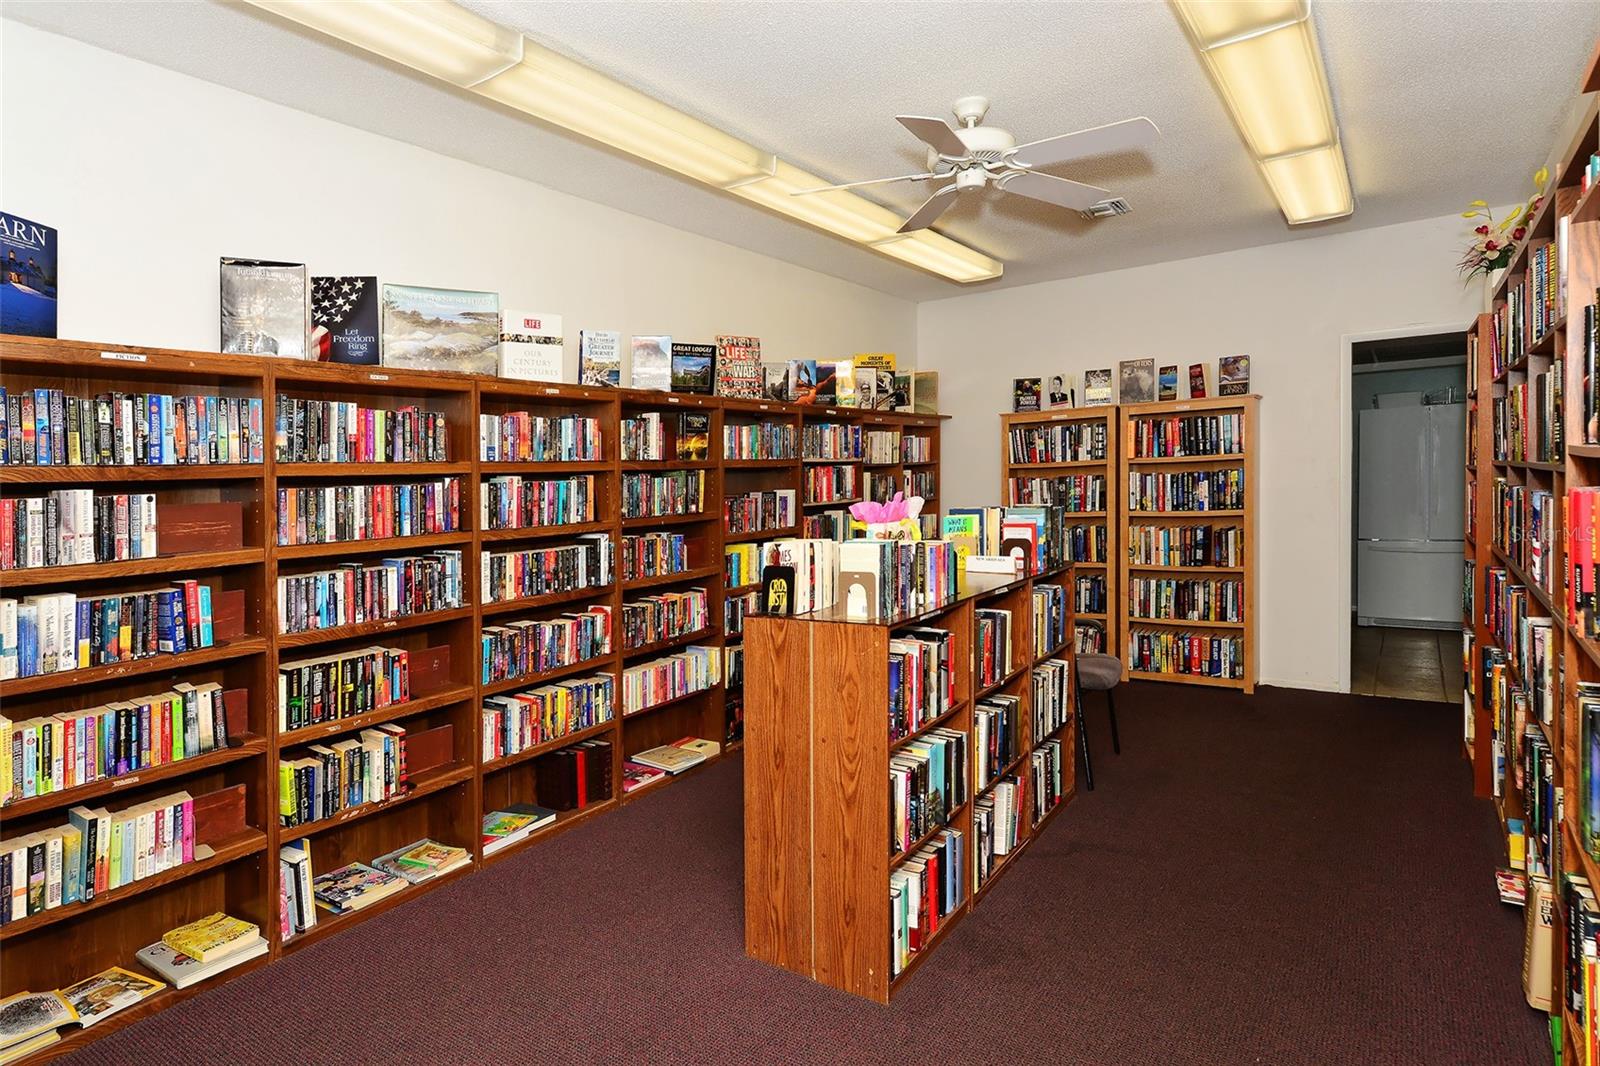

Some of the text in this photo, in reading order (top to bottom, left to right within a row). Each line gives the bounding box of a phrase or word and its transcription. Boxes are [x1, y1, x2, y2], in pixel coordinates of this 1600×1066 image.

[525, 319, 541, 329] LIFE
[333, 335, 375, 343] Freedom
[348, 342, 368, 351] Ring
[524, 350, 542, 358] OUR
[726, 347, 746, 359] LIFE
[513, 358, 552, 367] CENTURY
[517, 367, 559, 376] PICTURES
[733, 365, 755, 378] WAR
